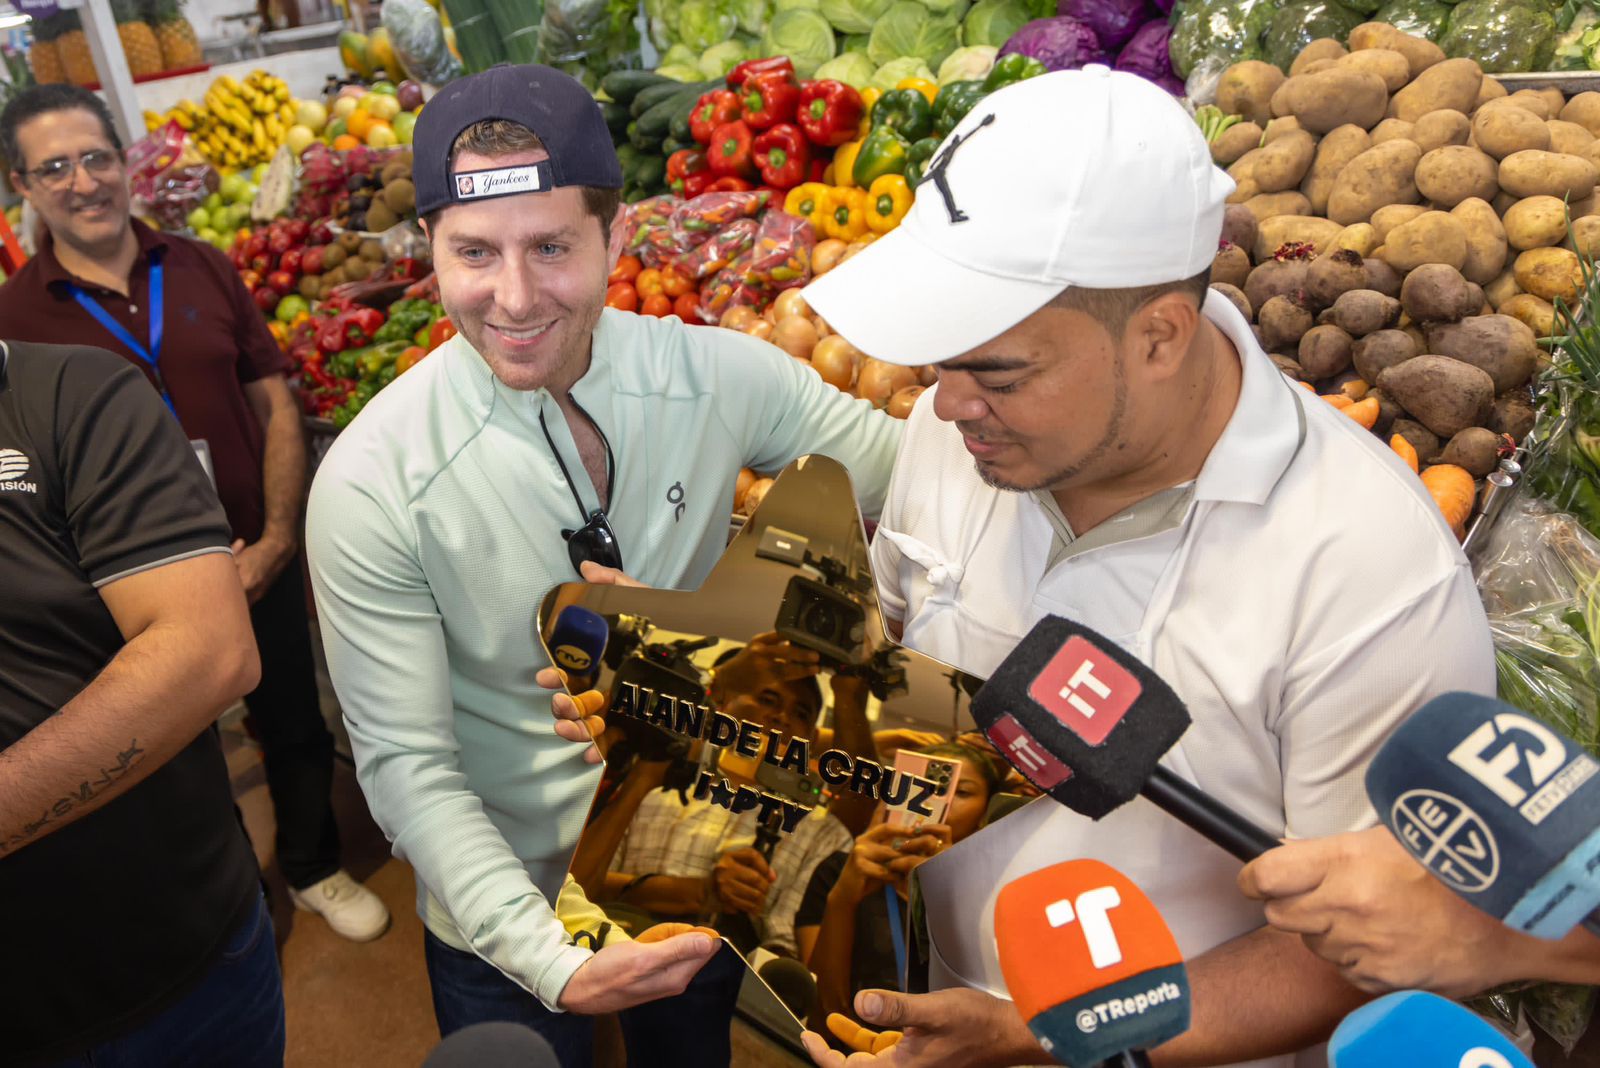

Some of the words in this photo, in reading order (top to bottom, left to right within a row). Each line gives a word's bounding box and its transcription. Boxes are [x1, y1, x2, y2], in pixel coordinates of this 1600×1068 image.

[481, 171, 530, 194] Yankees
[610, 681, 709, 739] ALAN
[708, 711, 764, 759] DE
[764, 729, 811, 776] LA
[818, 749, 940, 817] CRUZ
[1076, 982, 1182, 1033] @TReporta
